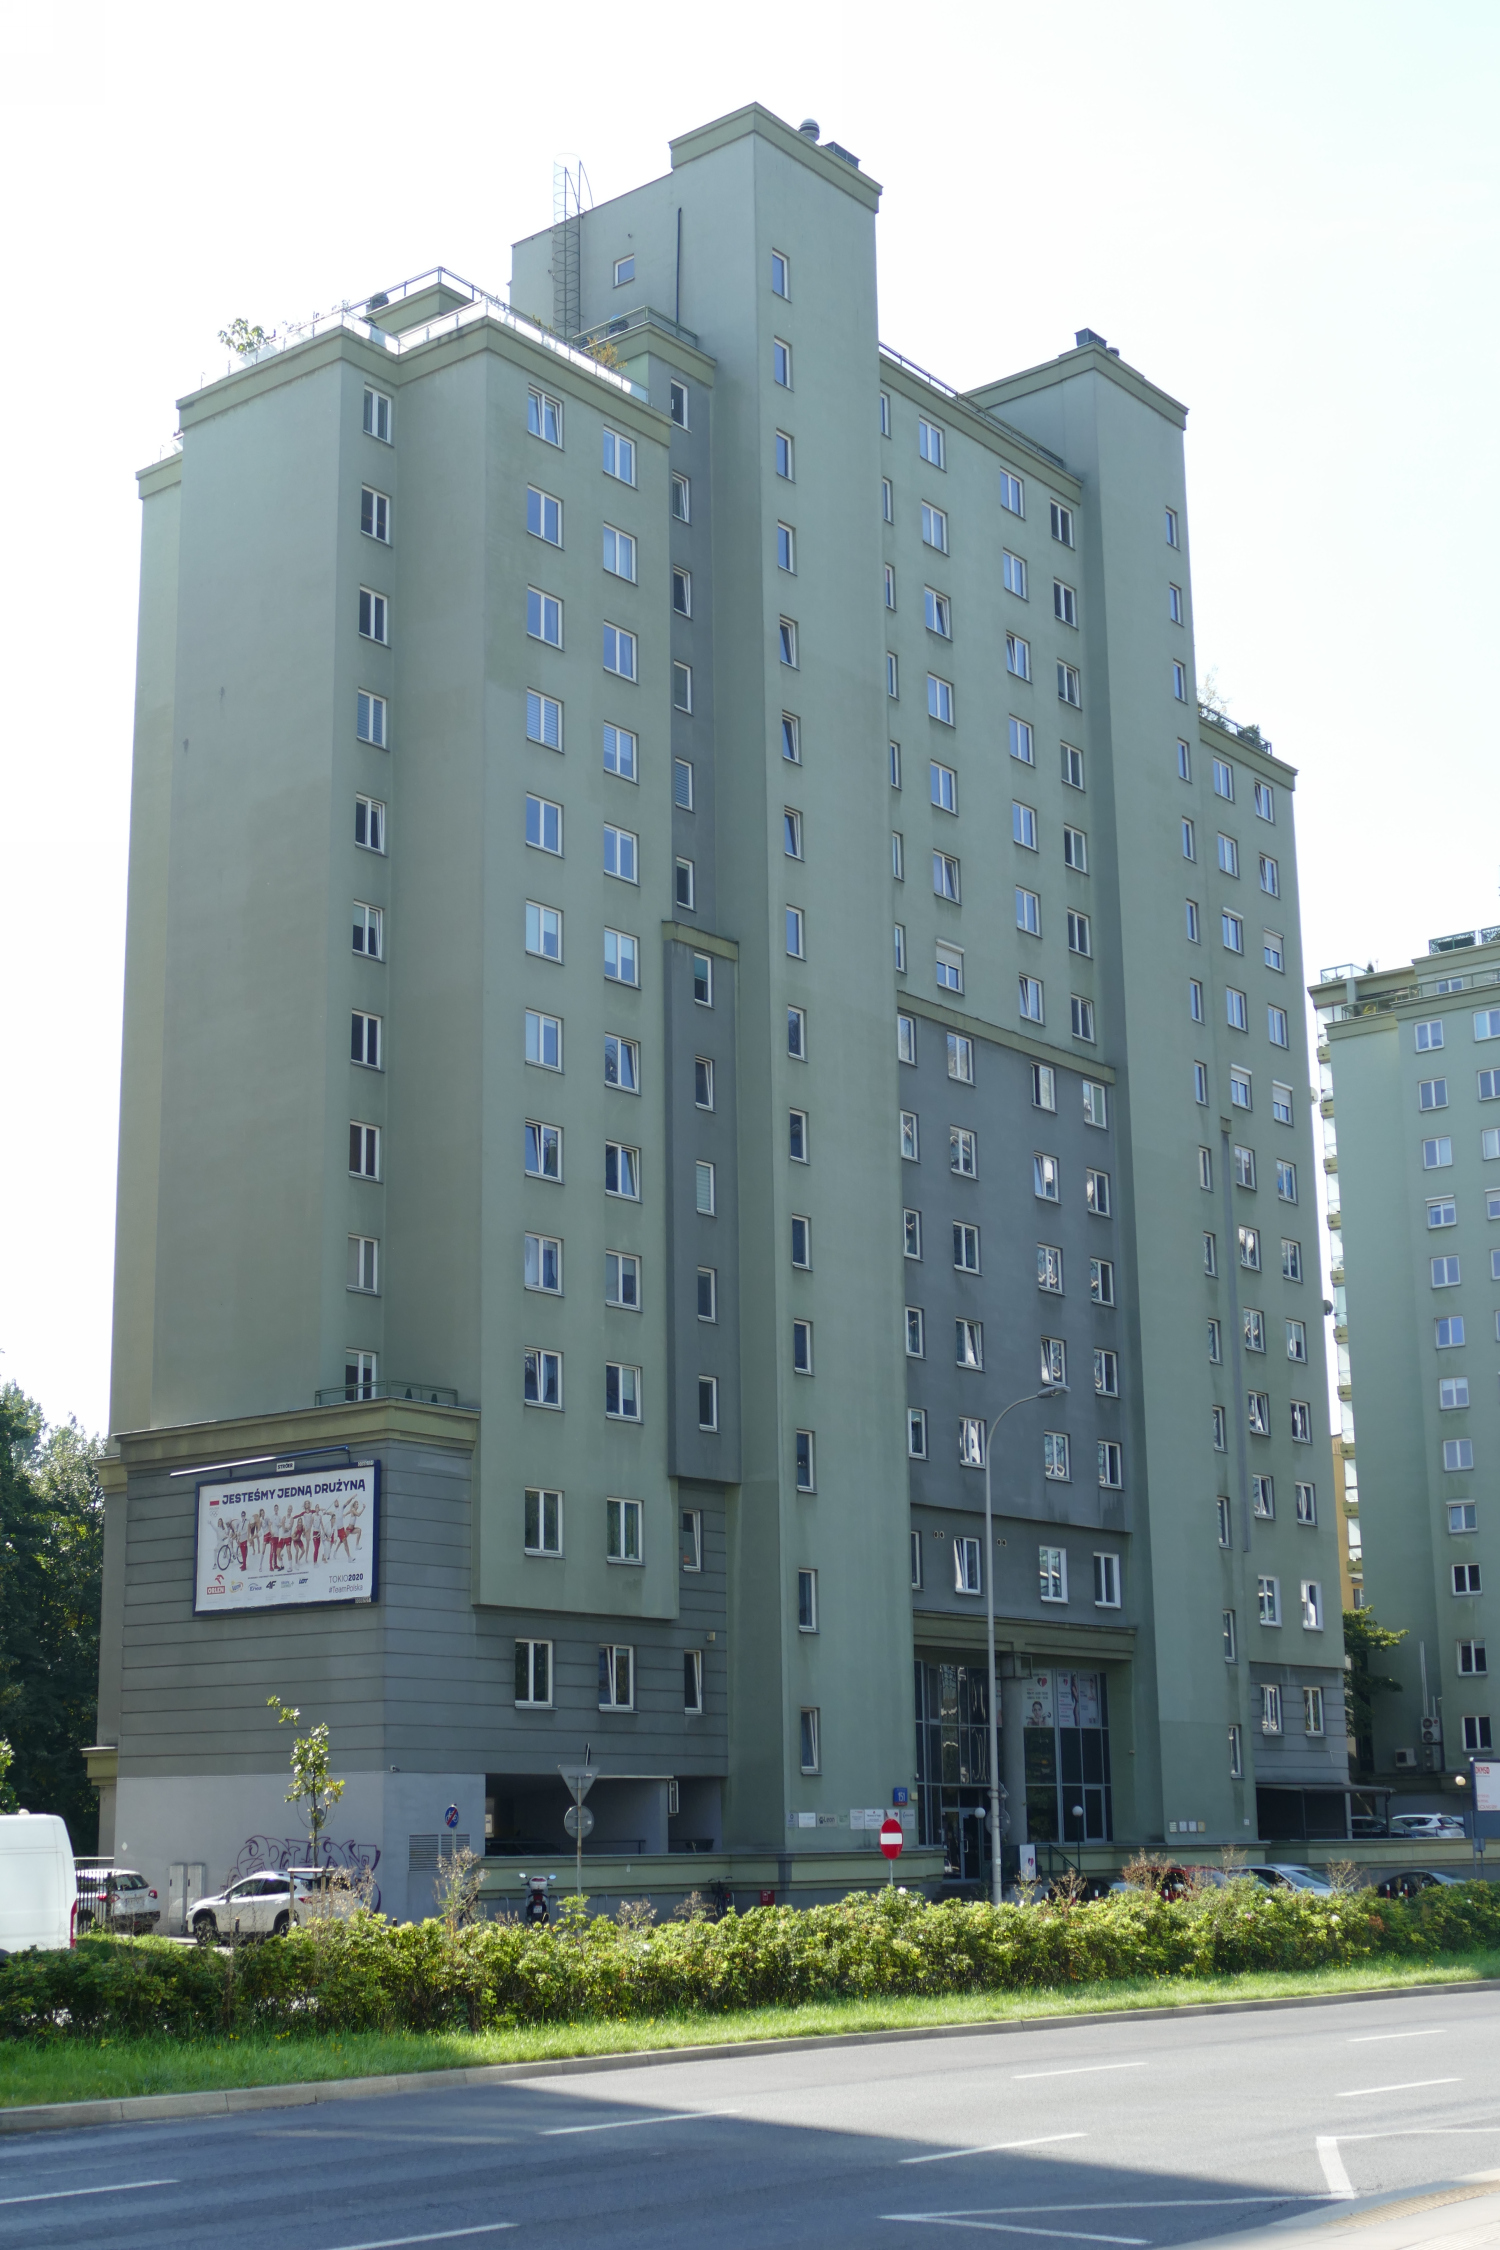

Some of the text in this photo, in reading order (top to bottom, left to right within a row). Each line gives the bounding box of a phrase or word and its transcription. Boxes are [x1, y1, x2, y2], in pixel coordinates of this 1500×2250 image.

[222, 1479, 366, 1505] JESTEŚMY JEDNĄ DRUŻYNĄ
[328, 1584, 363, 1593] #TeamPolska
[897, 1792, 906, 1802] 151
